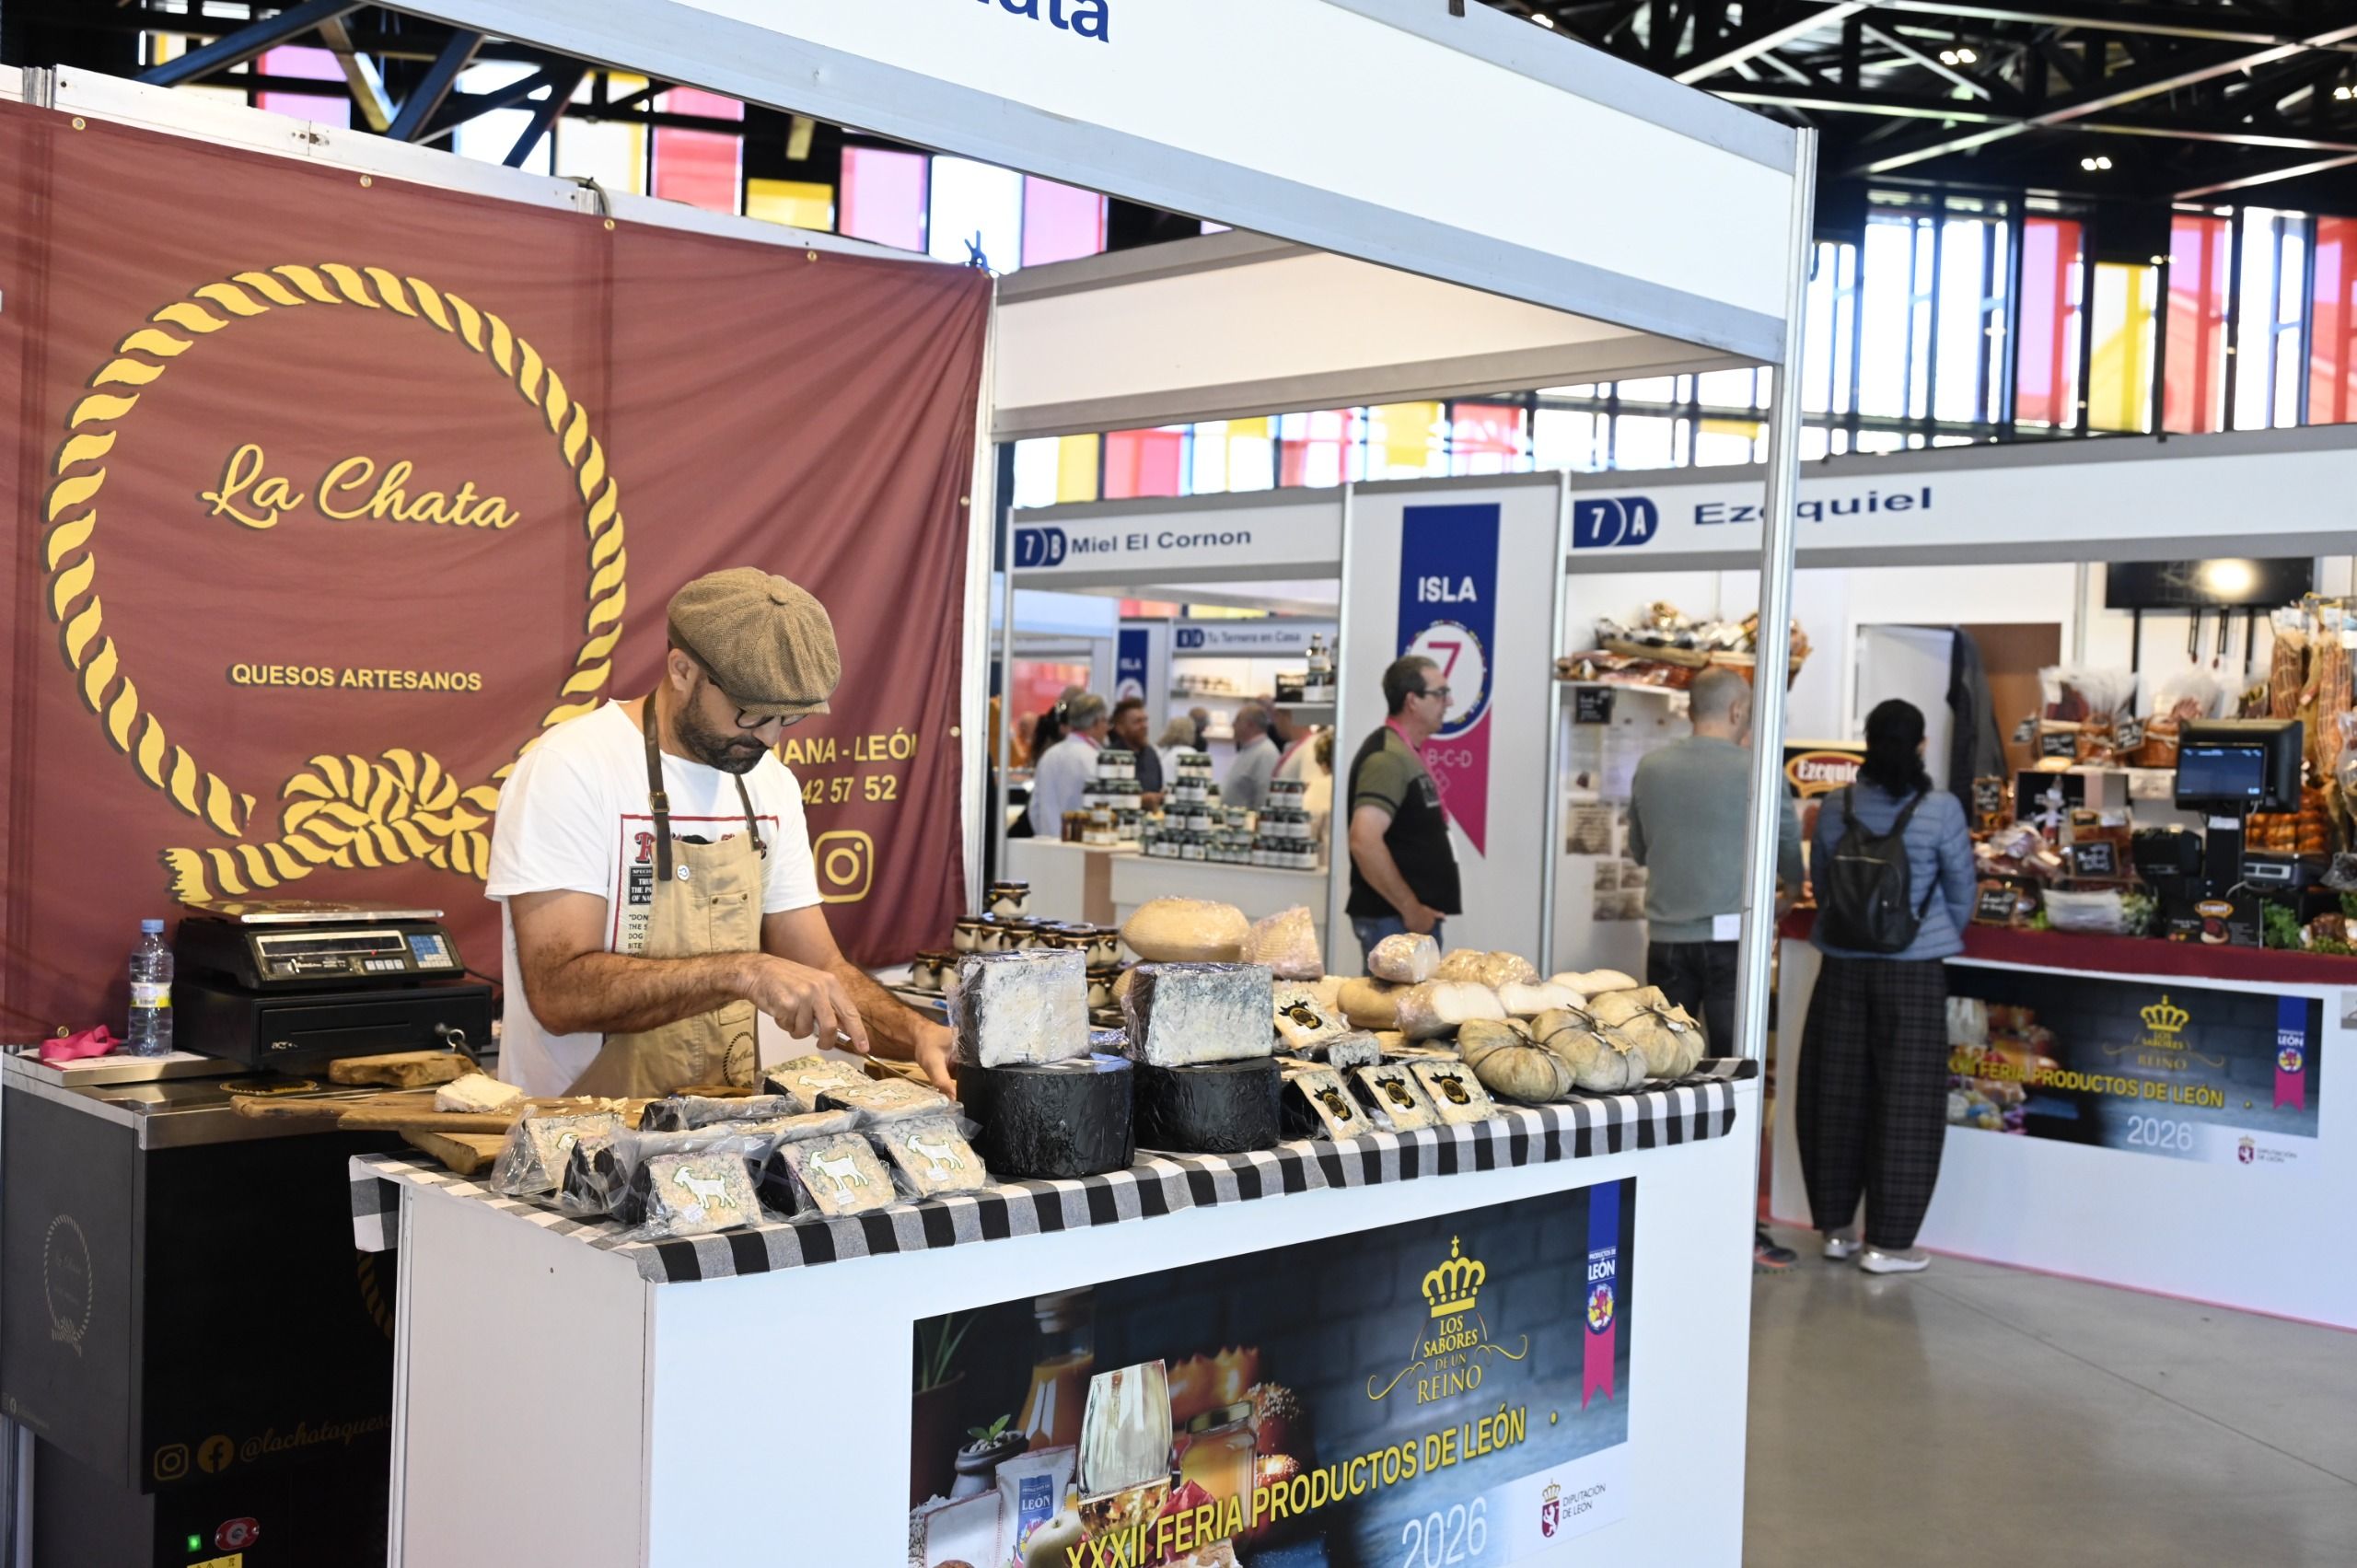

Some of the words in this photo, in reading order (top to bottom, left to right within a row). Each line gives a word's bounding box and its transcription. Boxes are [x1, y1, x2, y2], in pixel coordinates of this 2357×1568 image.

[202, 443, 305, 528] La
[318, 456, 521, 530] Chata
[1694, 487, 1932, 526] Ezquiel
[1591, 508, 1606, 539] 7
[1631, 505, 1647, 536] A
[1072, 536, 1117, 553] Miel
[1127, 534, 1148, 551] El
[1157, 531, 1251, 549] Cornon
[1418, 576, 1477, 602] ISLA
[231, 663, 334, 688] QUESOS
[341, 667, 482, 691] ARTESANOS
[830, 777, 854, 803] 57
[865, 774, 897, 801] 52
[2032, 1067, 2138, 1097] PRODUCTOS
[2143, 1082, 2166, 1100] DE
[2173, 1084, 2224, 1109] LEÓN
[2127, 1115, 2193, 1151] 2026
[1588, 1258, 1615, 1281] LEÓN
[1440, 1315, 1464, 1336] LOS
[1423, 1329, 1478, 1358] SABORES
[1435, 1358, 1447, 1371] DE
[1451, 1352, 1467, 1367] UN
[1417, 1365, 1482, 1405] REINO
[1065, 1523, 1146, 1568] XXXII
[1155, 1495, 1245, 1560] FERIA
[1251, 1446, 1418, 1528] PRODUCTOS
[1424, 1434, 1457, 1472] DE
[1464, 1402, 1527, 1459] LEÓN
[1022, 1493, 1050, 1510] LEÓN
[1402, 1496, 1487, 1568] 2026
